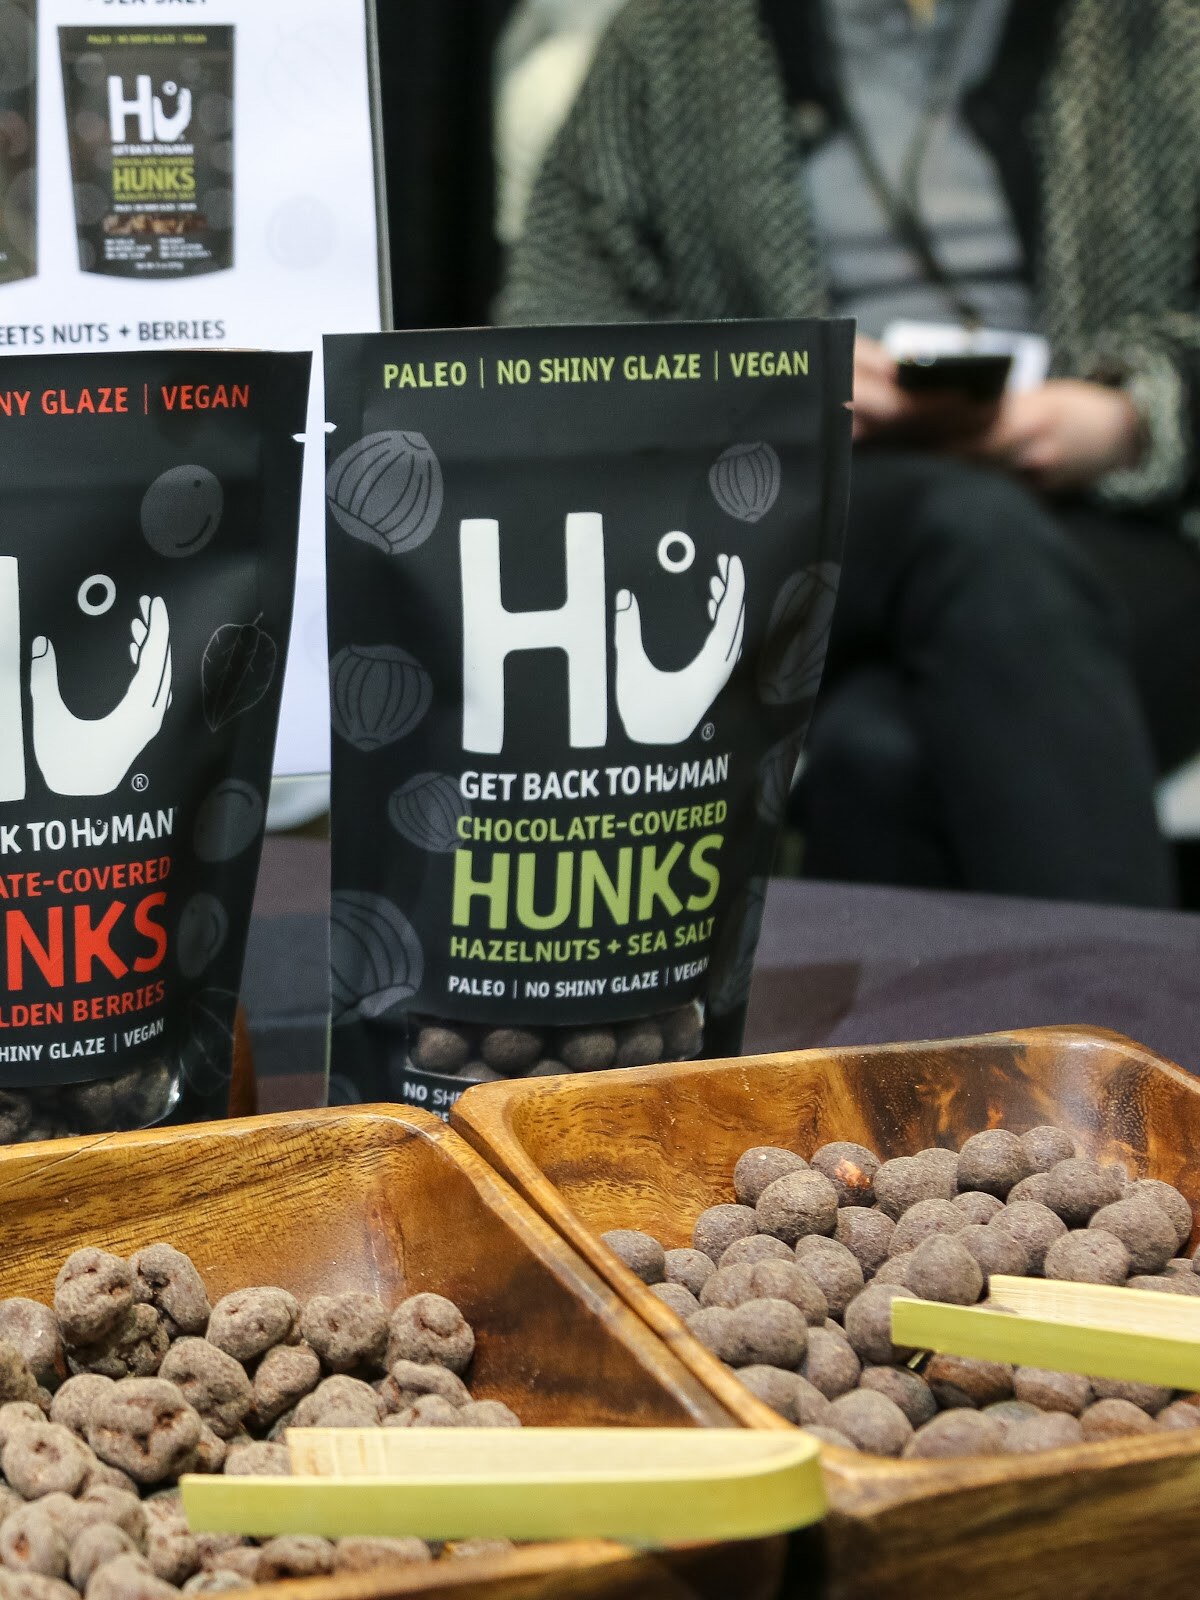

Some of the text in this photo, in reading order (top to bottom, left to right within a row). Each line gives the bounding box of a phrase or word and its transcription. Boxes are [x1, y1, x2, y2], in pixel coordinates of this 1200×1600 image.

[113, 166, 196, 191] HUNKS
[52, 323, 109, 343] NUTS
[138, 320, 225, 341] BERRIES
[384, 351, 808, 389] PALEO NO SHINY GLAZE VEGAN
[42, 388, 128, 414] GLAZE
[161, 385, 248, 410] VEGAN
[459, 771, 517, 801] GET
[523, 769, 599, 801] BACK
[605, 766, 640, 795] TO
[27, 820, 66, 851] TO
[457, 800, 727, 843] CHOCOLATE-COVERED
[452, 834, 725, 931] HUNKS
[450, 936, 600, 962] HAZELNUTS
[628, 930, 667, 956] SEA
[674, 917, 714, 947] SALT
[448, 976, 505, 996] PALEO
[525, 982, 550, 998] NO
[555, 979, 607, 997] SHINY
[611, 970, 659, 993] GLAZE
[72, 982, 163, 1022] BERRIES
[49, 1037, 105, 1059] GLAZE
[123, 1018, 163, 1047] VEGAN
[403, 1081, 428, 1101] NO
